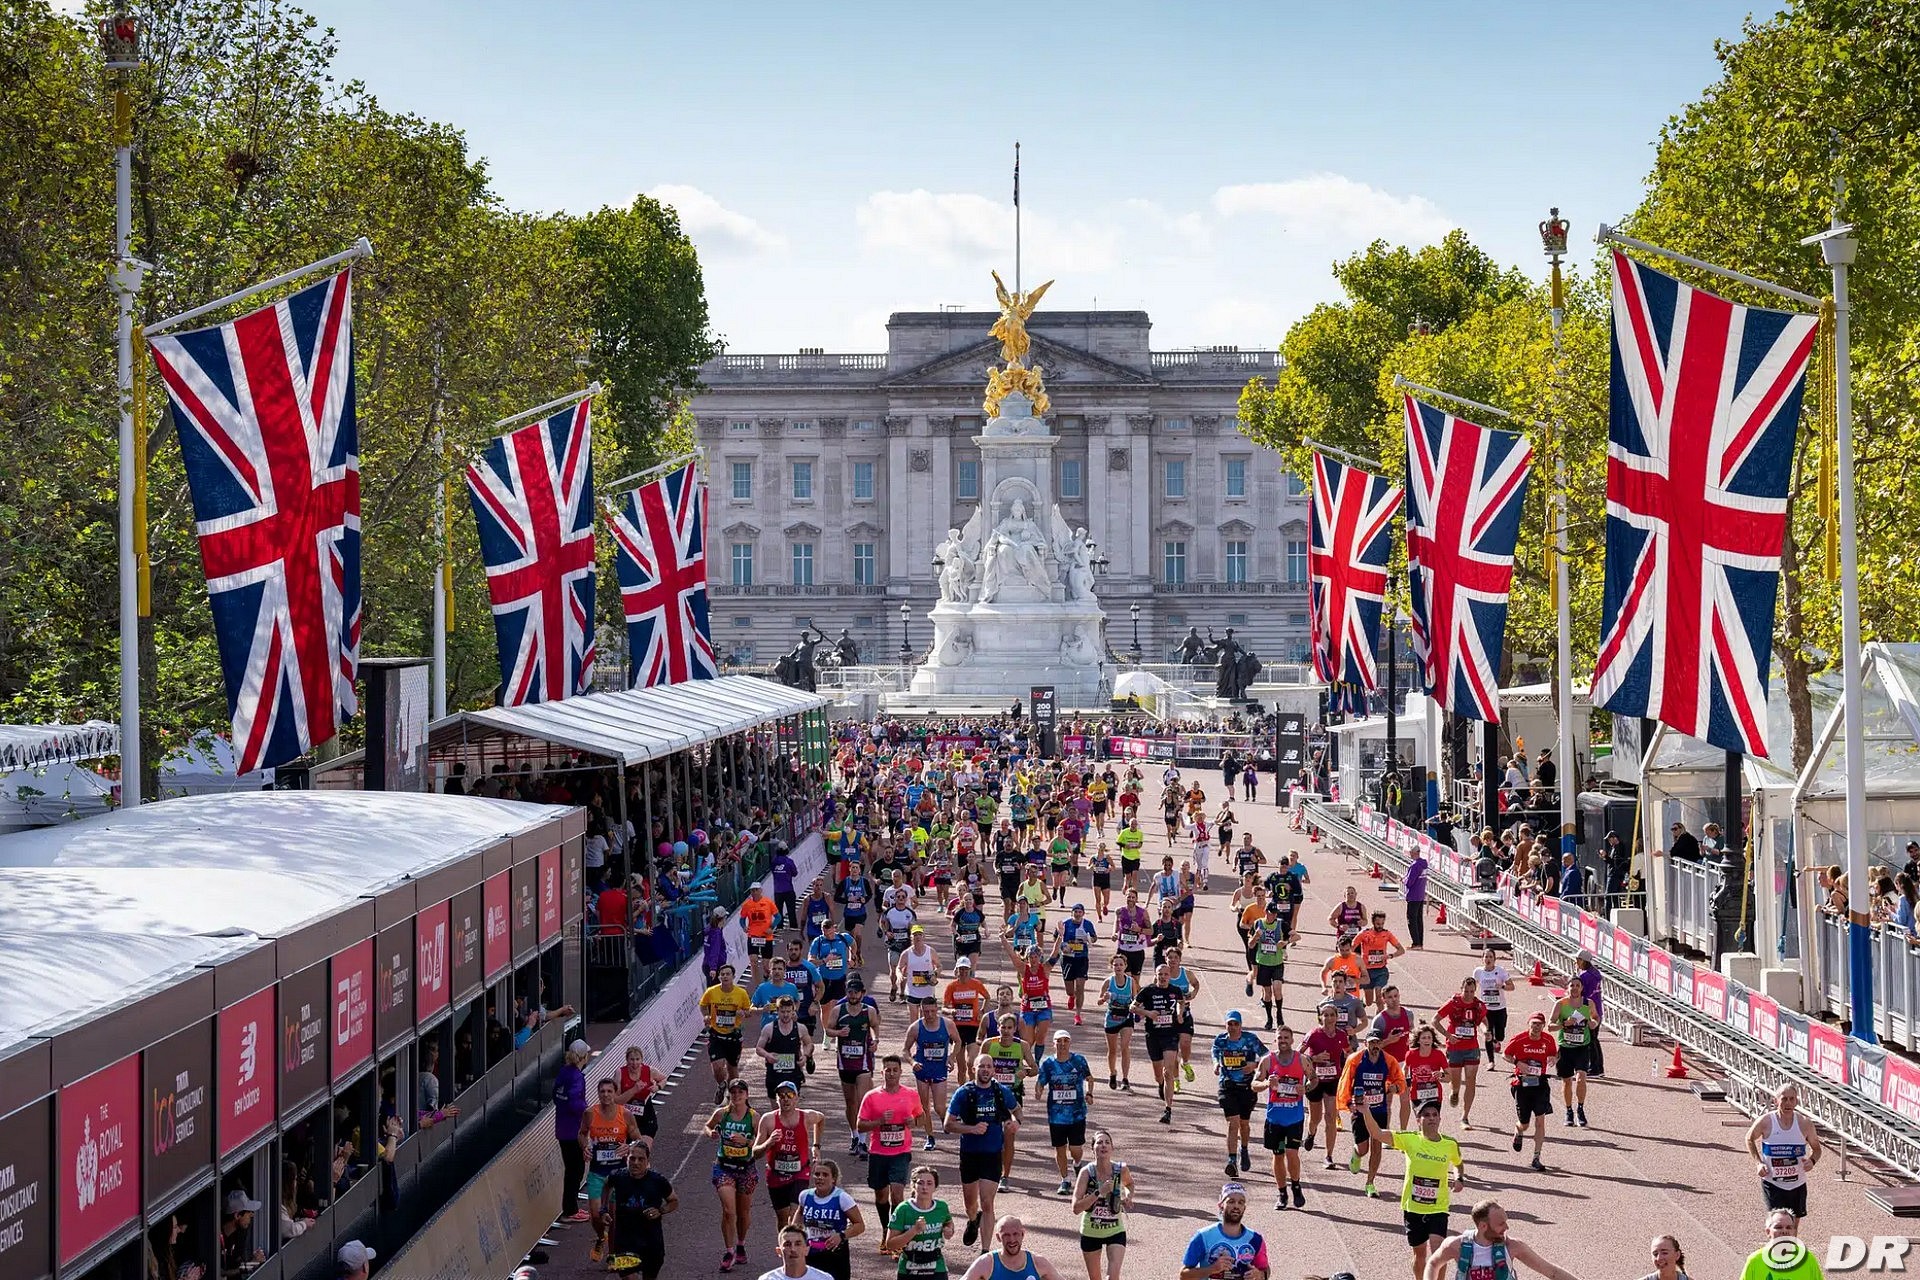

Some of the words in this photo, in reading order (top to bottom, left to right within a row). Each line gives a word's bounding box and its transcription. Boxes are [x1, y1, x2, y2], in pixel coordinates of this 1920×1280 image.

[420, 934, 433, 988] tcs
[783, 970, 808, 979] STEVEN
[301, 1003, 311, 1022] TATA
[285, 1015, 300, 1074] tcs
[301, 1018, 322, 1044] CONSULTANCY
[301, 1042, 315, 1065] SERVICES
[175, 1069, 189, 1094] TATA
[100, 1103, 109, 1121] THE
[175, 1085, 204, 1118] CONSULTANCY
[234, 1098, 243, 1118] new
[243, 1086, 260, 1112] balance
[153, 1087, 175, 1158] tcs
[175, 1116, 195, 1144] SERVICES
[725, 1122, 746, 1131] KATY
[100, 1122, 123, 1160] ROYAL
[100, 1159, 123, 1198] PARKS
[1775, 1167, 1796, 1175] 37209
[0, 1181, 38, 1222] ONSULTANCY
[1414, 1186, 1436, 1197] 39205
[802, 1205, 841, 1220] SASKIA
[0, 1219, 24, 1253] ERVICES
